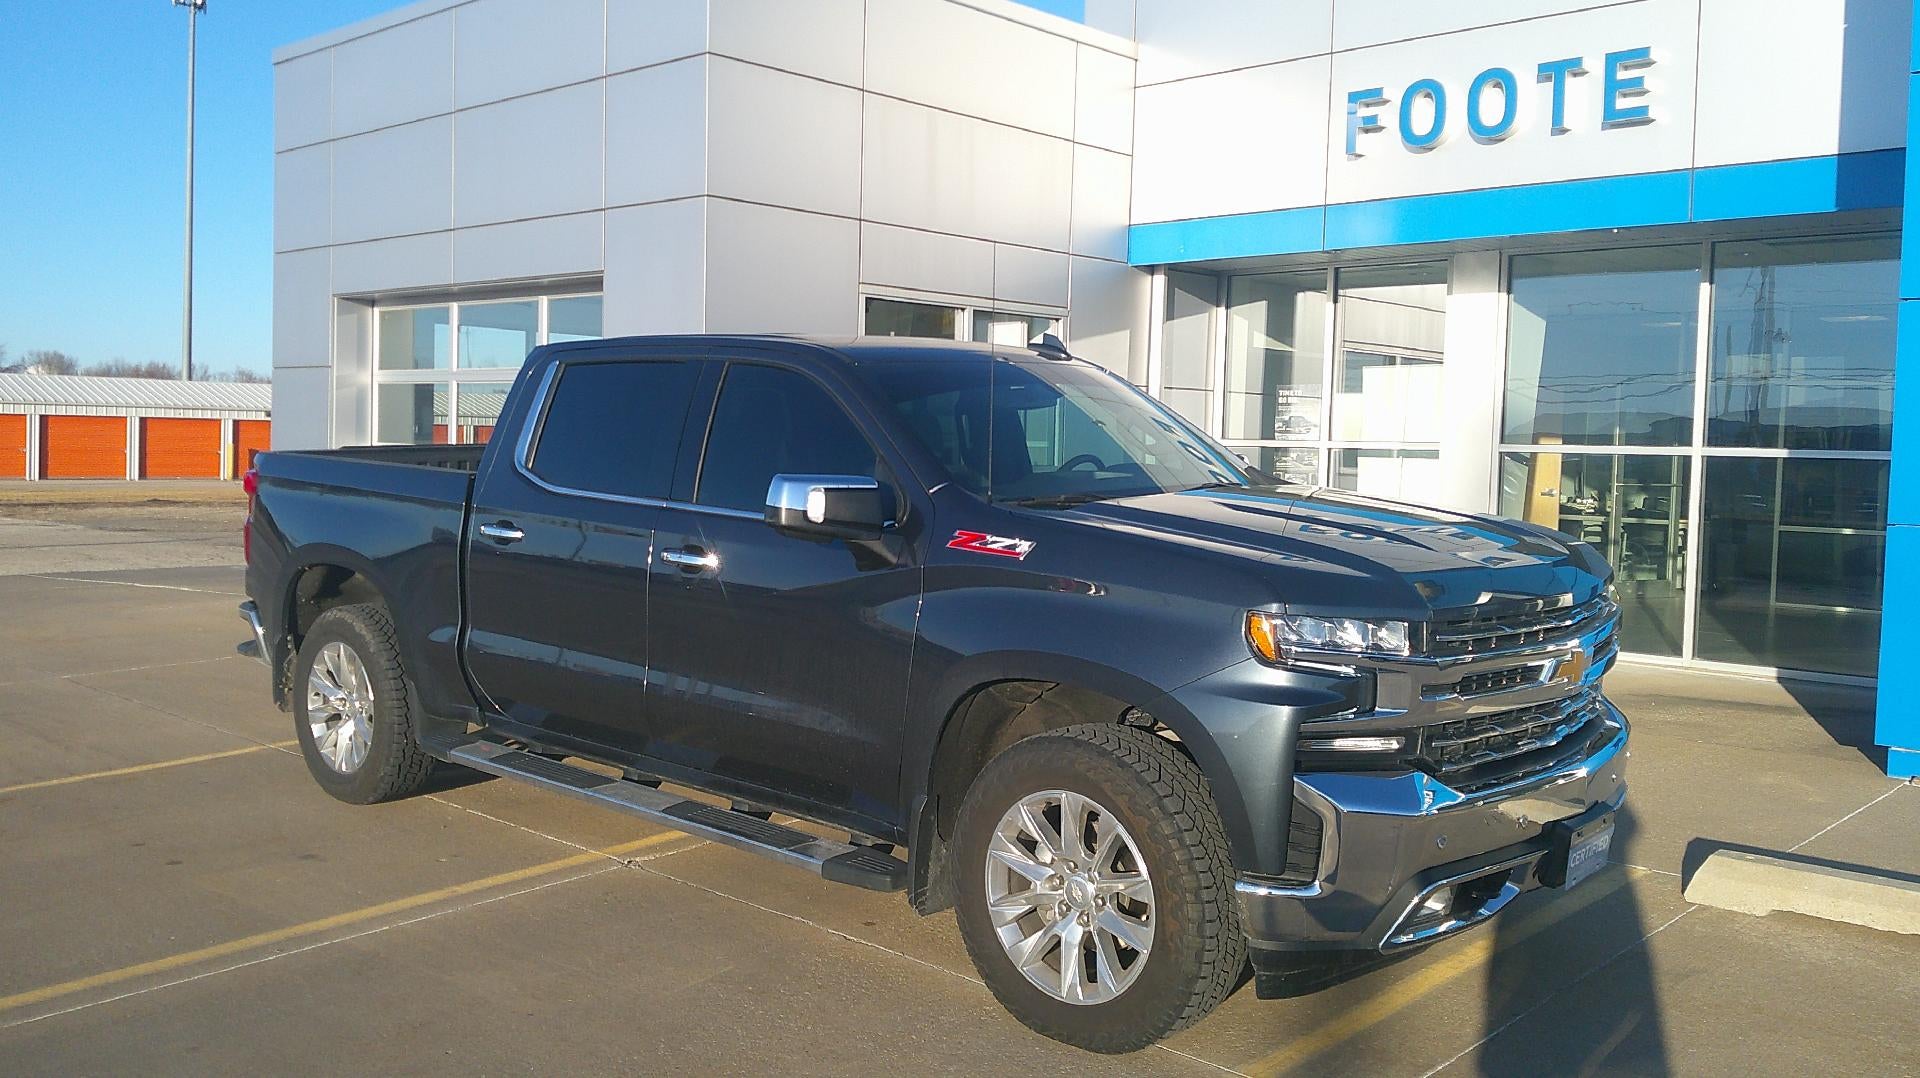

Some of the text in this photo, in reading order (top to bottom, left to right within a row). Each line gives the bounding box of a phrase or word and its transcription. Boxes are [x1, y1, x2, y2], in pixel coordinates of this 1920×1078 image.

[1346, 47, 1655, 160] FOOTE
[946, 529, 1037, 560] Z71
[1570, 835, 1609, 868] CERTIFIED
